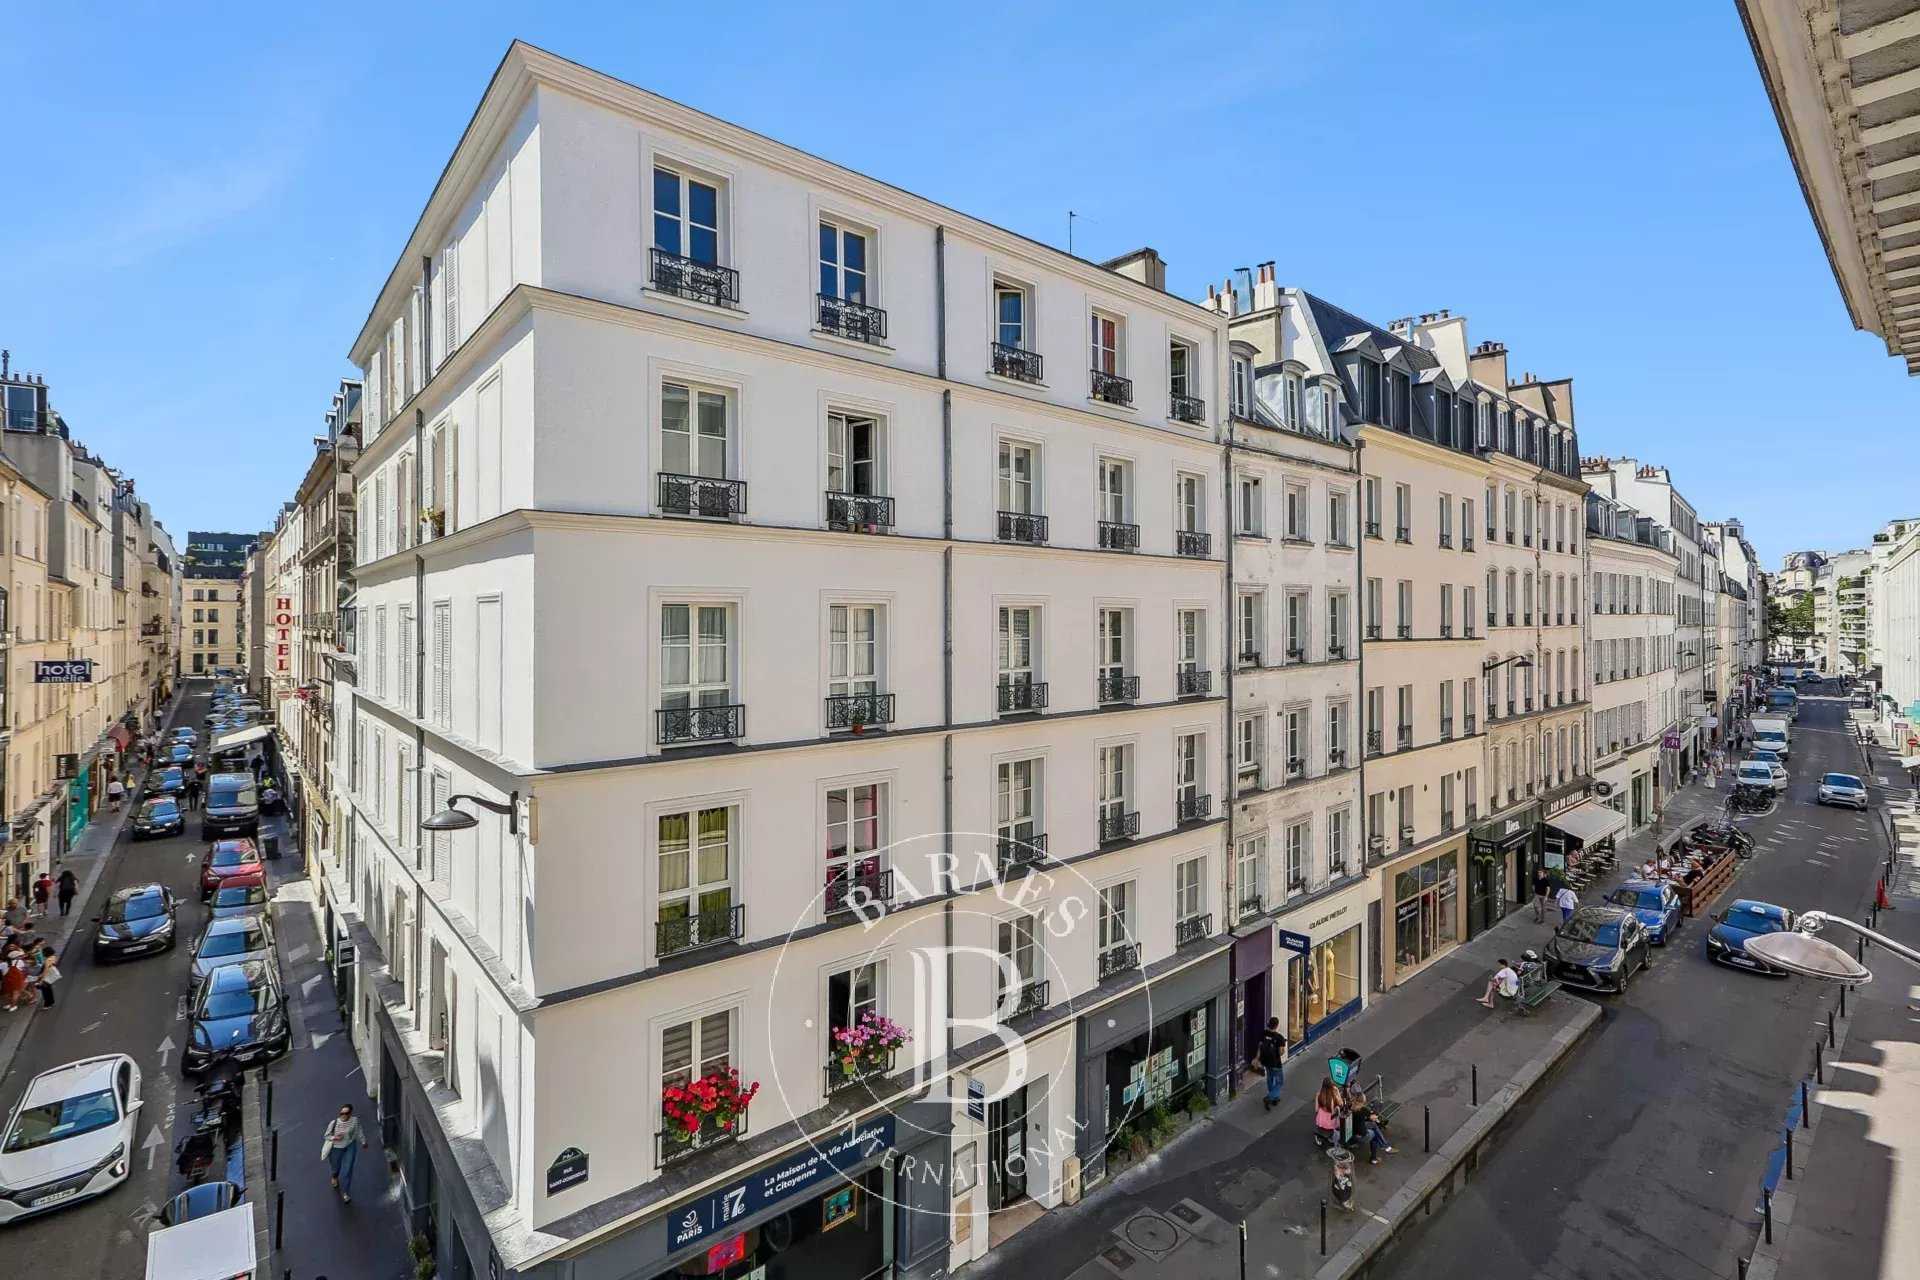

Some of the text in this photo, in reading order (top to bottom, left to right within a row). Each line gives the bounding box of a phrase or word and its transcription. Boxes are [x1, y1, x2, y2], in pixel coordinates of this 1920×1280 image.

[276, 598, 291, 671] HOTEL
[37, 661, 90, 675] hotel
[764, 1176, 775, 1187] La
[776, 1162, 806, 1181] Maison
[807, 1156, 818, 1167] de
[828, 1144, 841, 1156] Vie
[842, 1126, 885, 1151] Associative
[764, 1167, 817, 1198] et Citoyenne
[677, 1225, 703, 1244] PARIS
